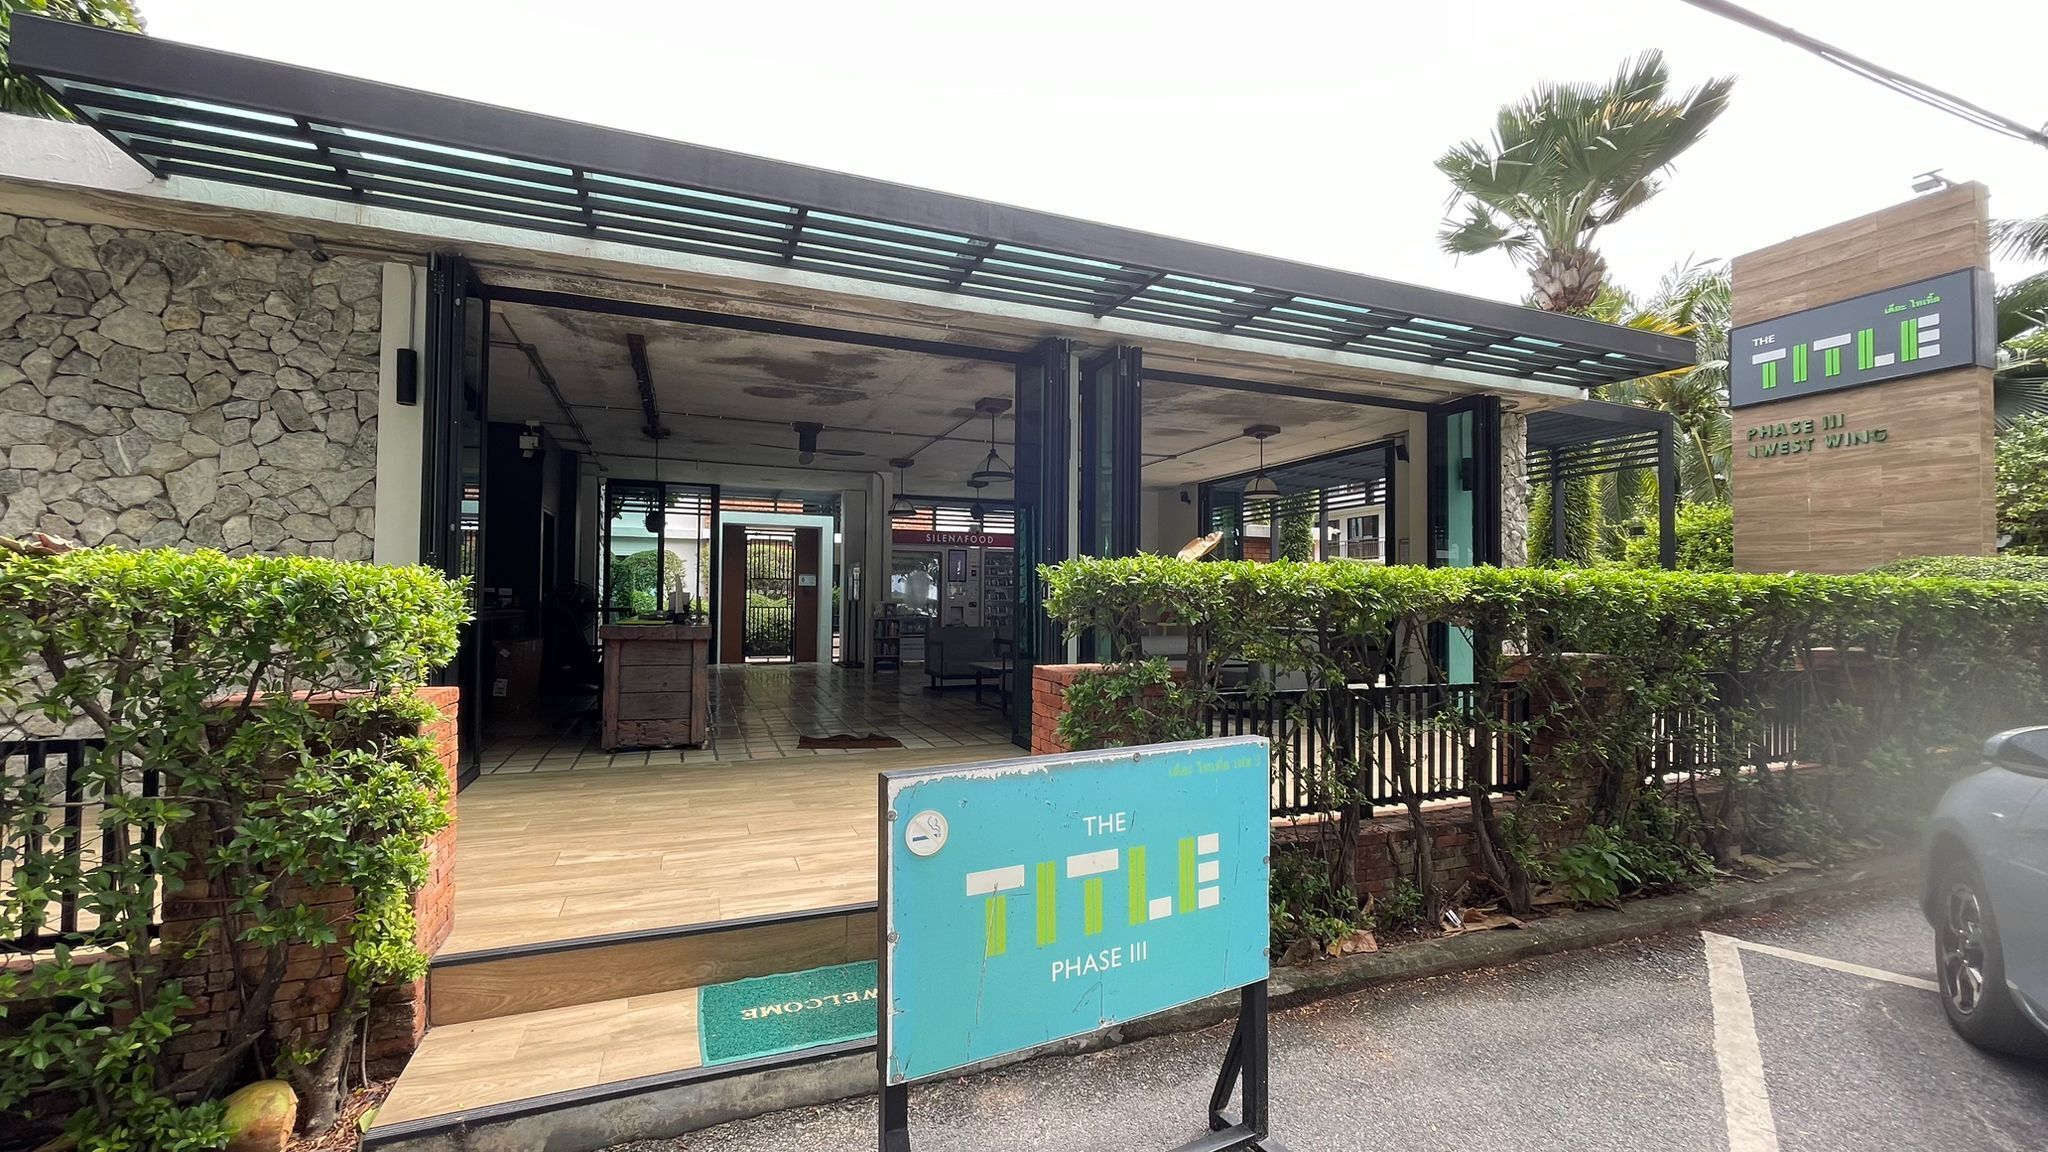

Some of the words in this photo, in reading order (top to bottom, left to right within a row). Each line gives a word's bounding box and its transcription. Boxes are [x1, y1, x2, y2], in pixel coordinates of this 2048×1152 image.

[1752, 334, 1776, 347] THE
[1752, 313, 1940, 390] TITLE
[1747, 419, 1814, 440] PHASE
[1822, 413, 1845, 430] III
[1764, 438, 1816, 457] WEST
[1824, 429, 1888, 448] WING
[926, 533, 994, 544] SILENAFOOD
[1083, 811, 1126, 837] THE
[966, 832, 1219, 958] TITLE
[1052, 946, 1122, 983] PHASE
[1130, 940, 1148, 963] III
